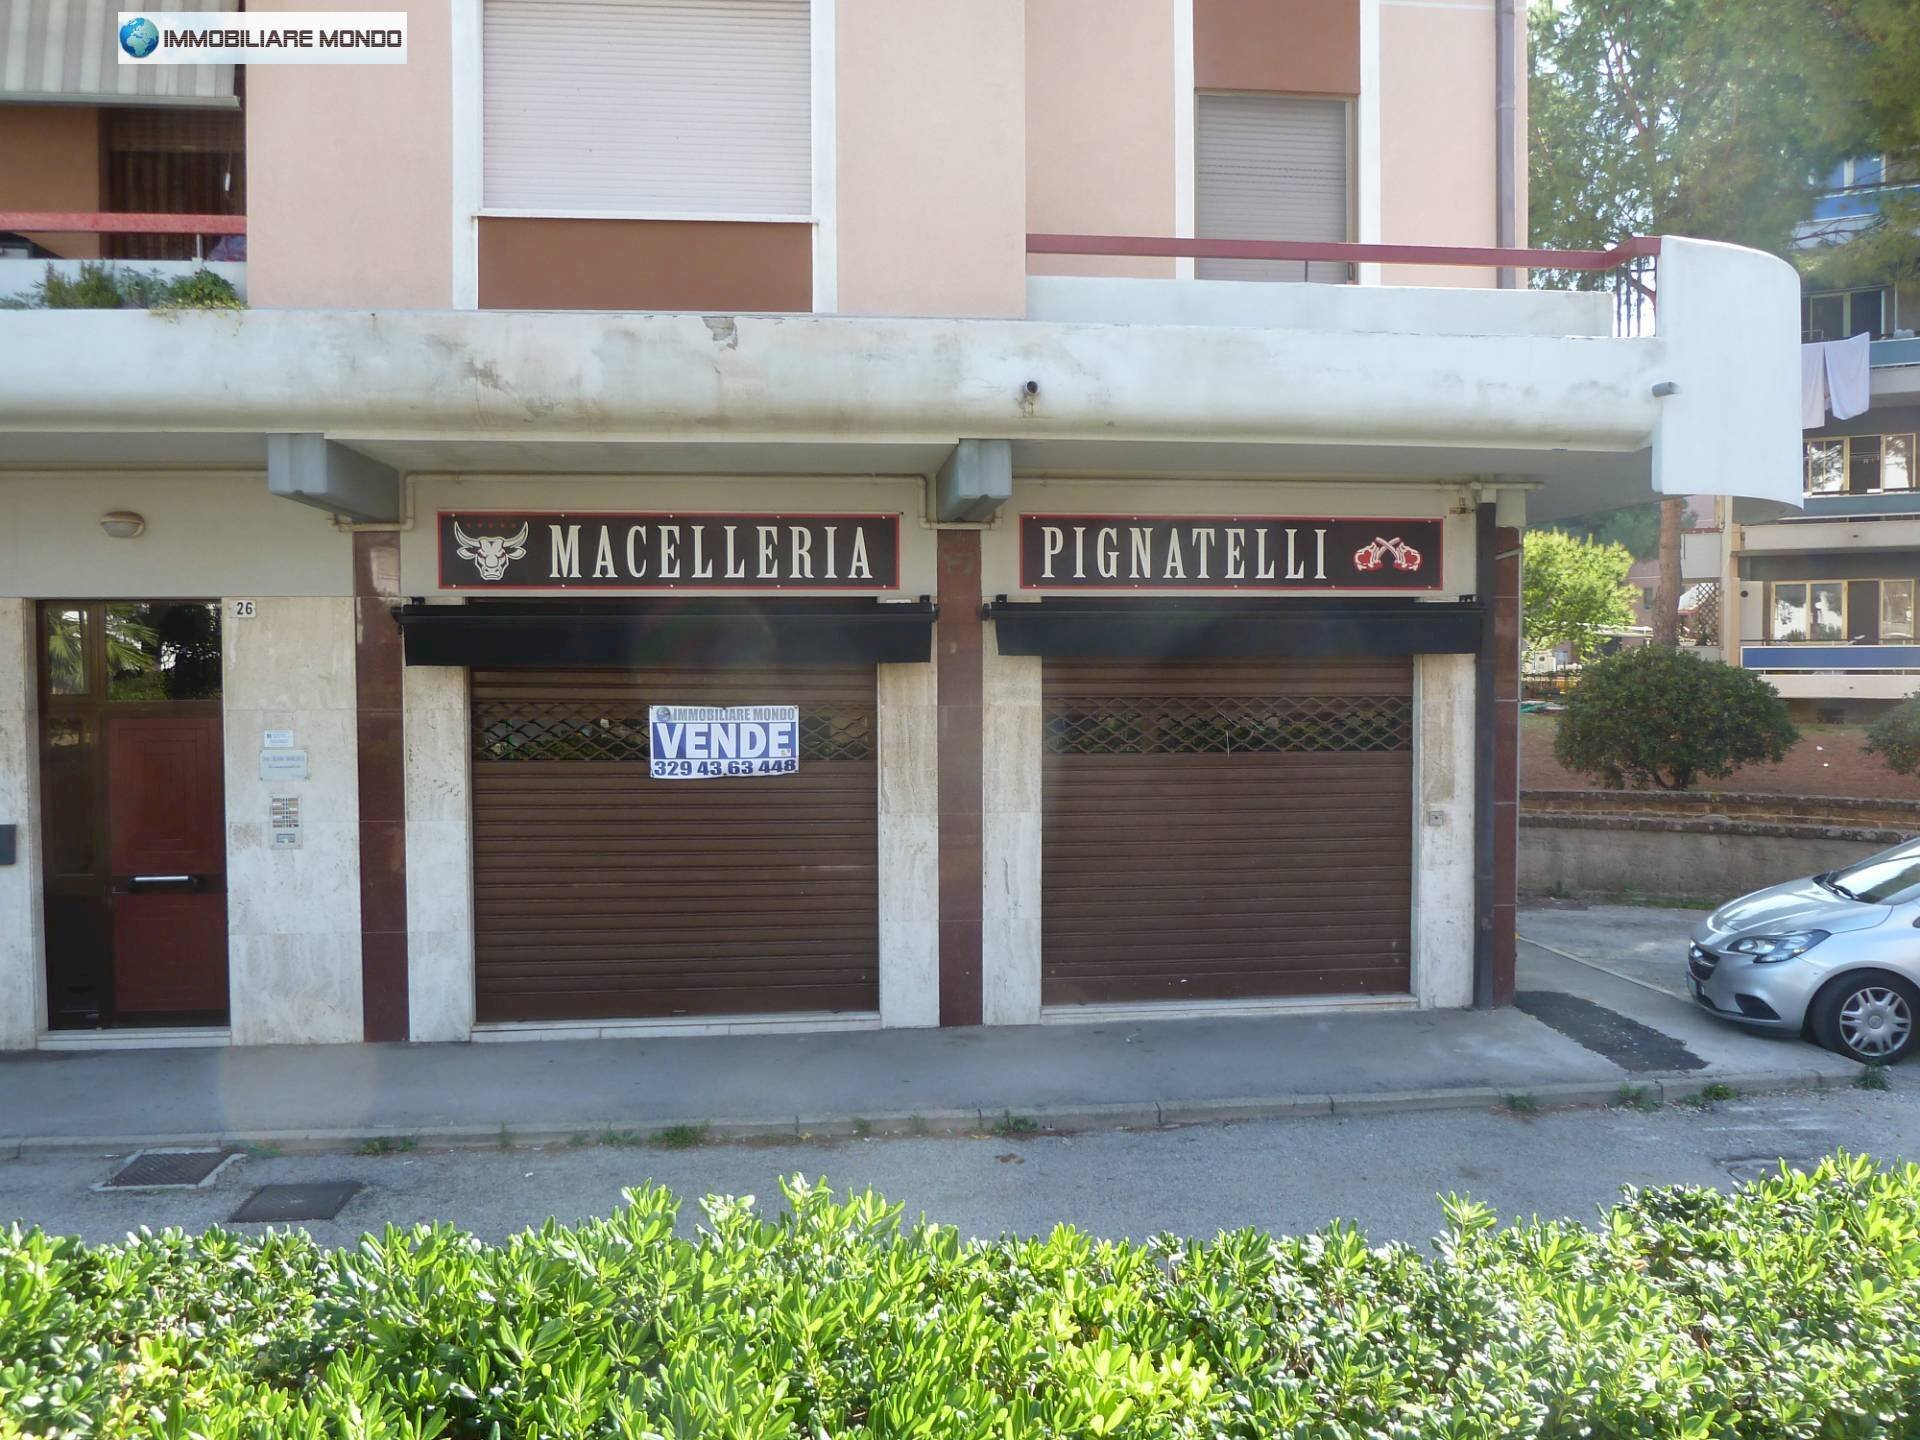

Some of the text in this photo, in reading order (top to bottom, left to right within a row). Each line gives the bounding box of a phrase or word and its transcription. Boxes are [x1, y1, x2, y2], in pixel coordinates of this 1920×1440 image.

[548, 524, 874, 580] MACELLERIA
[1040, 526, 1328, 580] PIGNATELLI
[236, 601, 254, 616] 26
[673, 707, 795, 721] IMMOBILIARE MONDO
[656, 722, 792, 759] VENDE
[654, 759, 796, 776] 329 43 63 448
